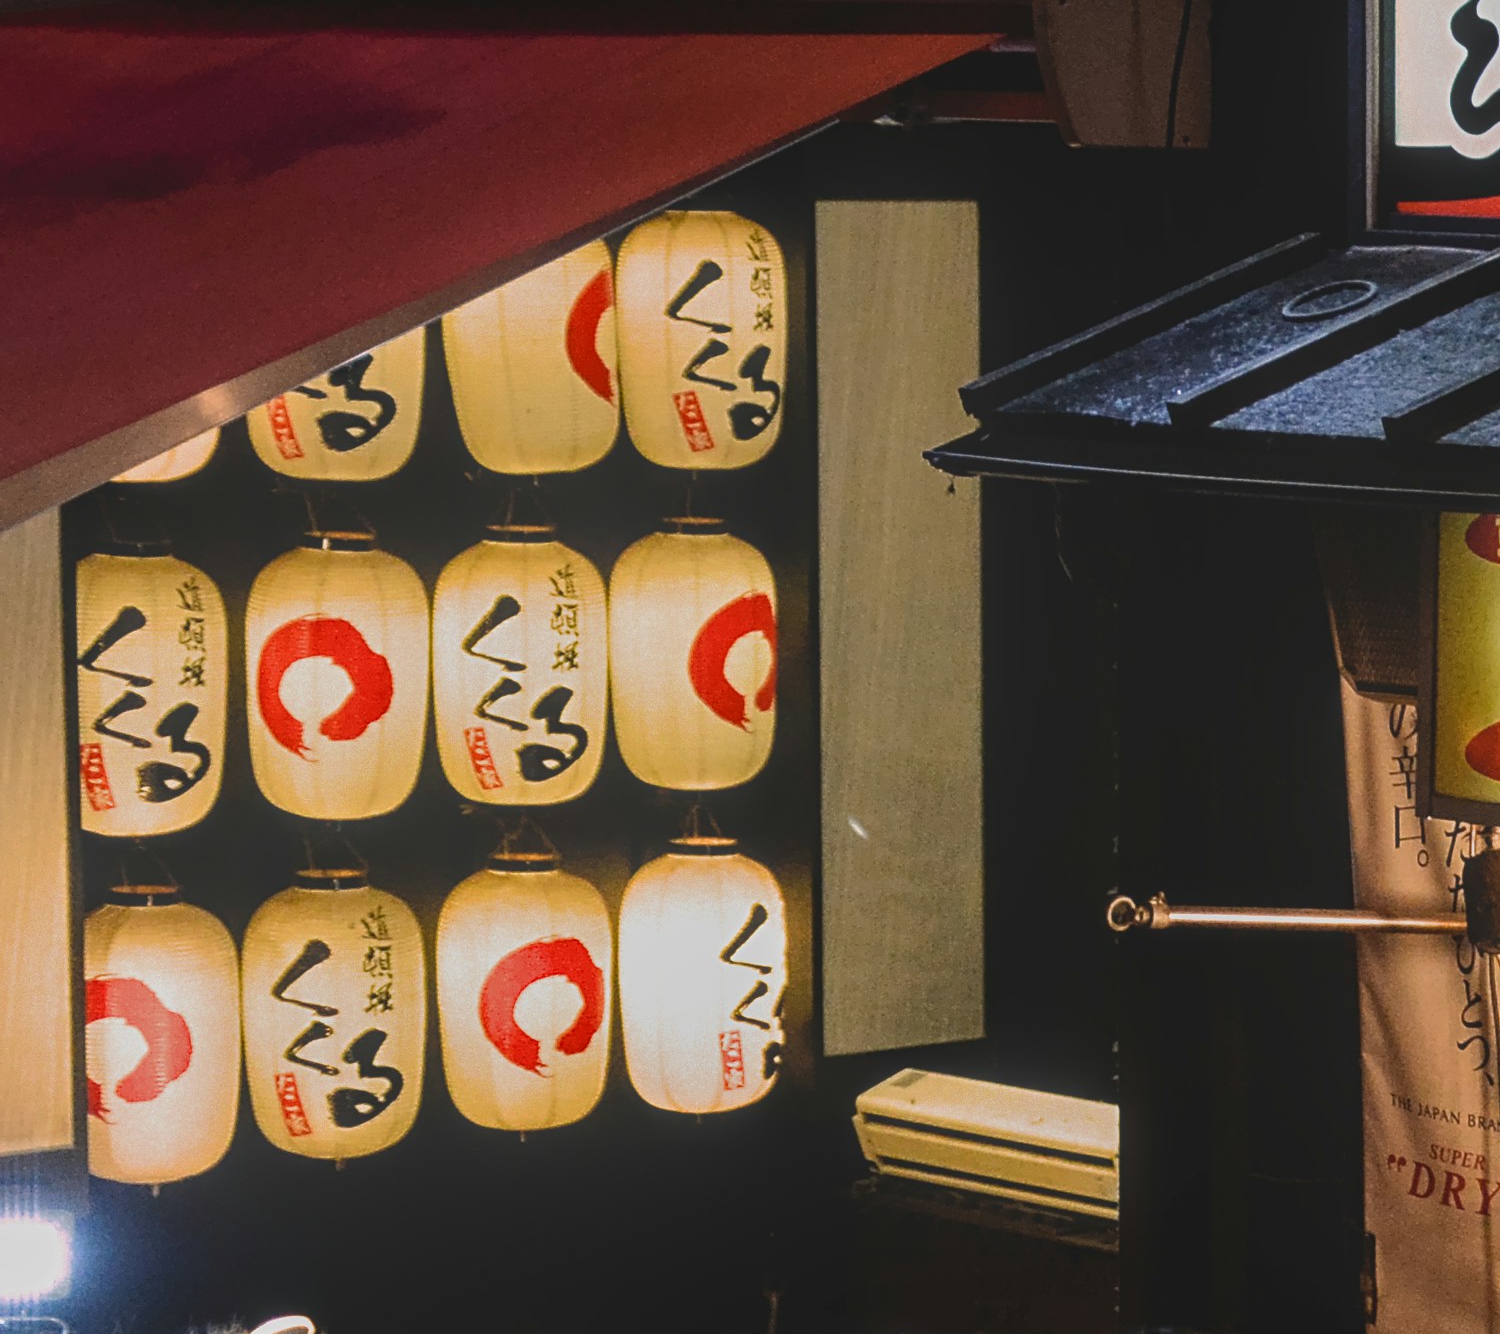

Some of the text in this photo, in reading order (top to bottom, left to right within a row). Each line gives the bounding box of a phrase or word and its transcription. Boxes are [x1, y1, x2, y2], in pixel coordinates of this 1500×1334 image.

[664, 258, 781, 441] くくる
[76, 605, 213, 803] くくる
[461, 594, 588, 782] くくる
[270, 938, 404, 1129] くくる
[1391, 1092, 1414, 1111] THE
[1417, 1099, 1462, 1126] JAPAN
[1429, 1142, 1486, 1171] SUPER
